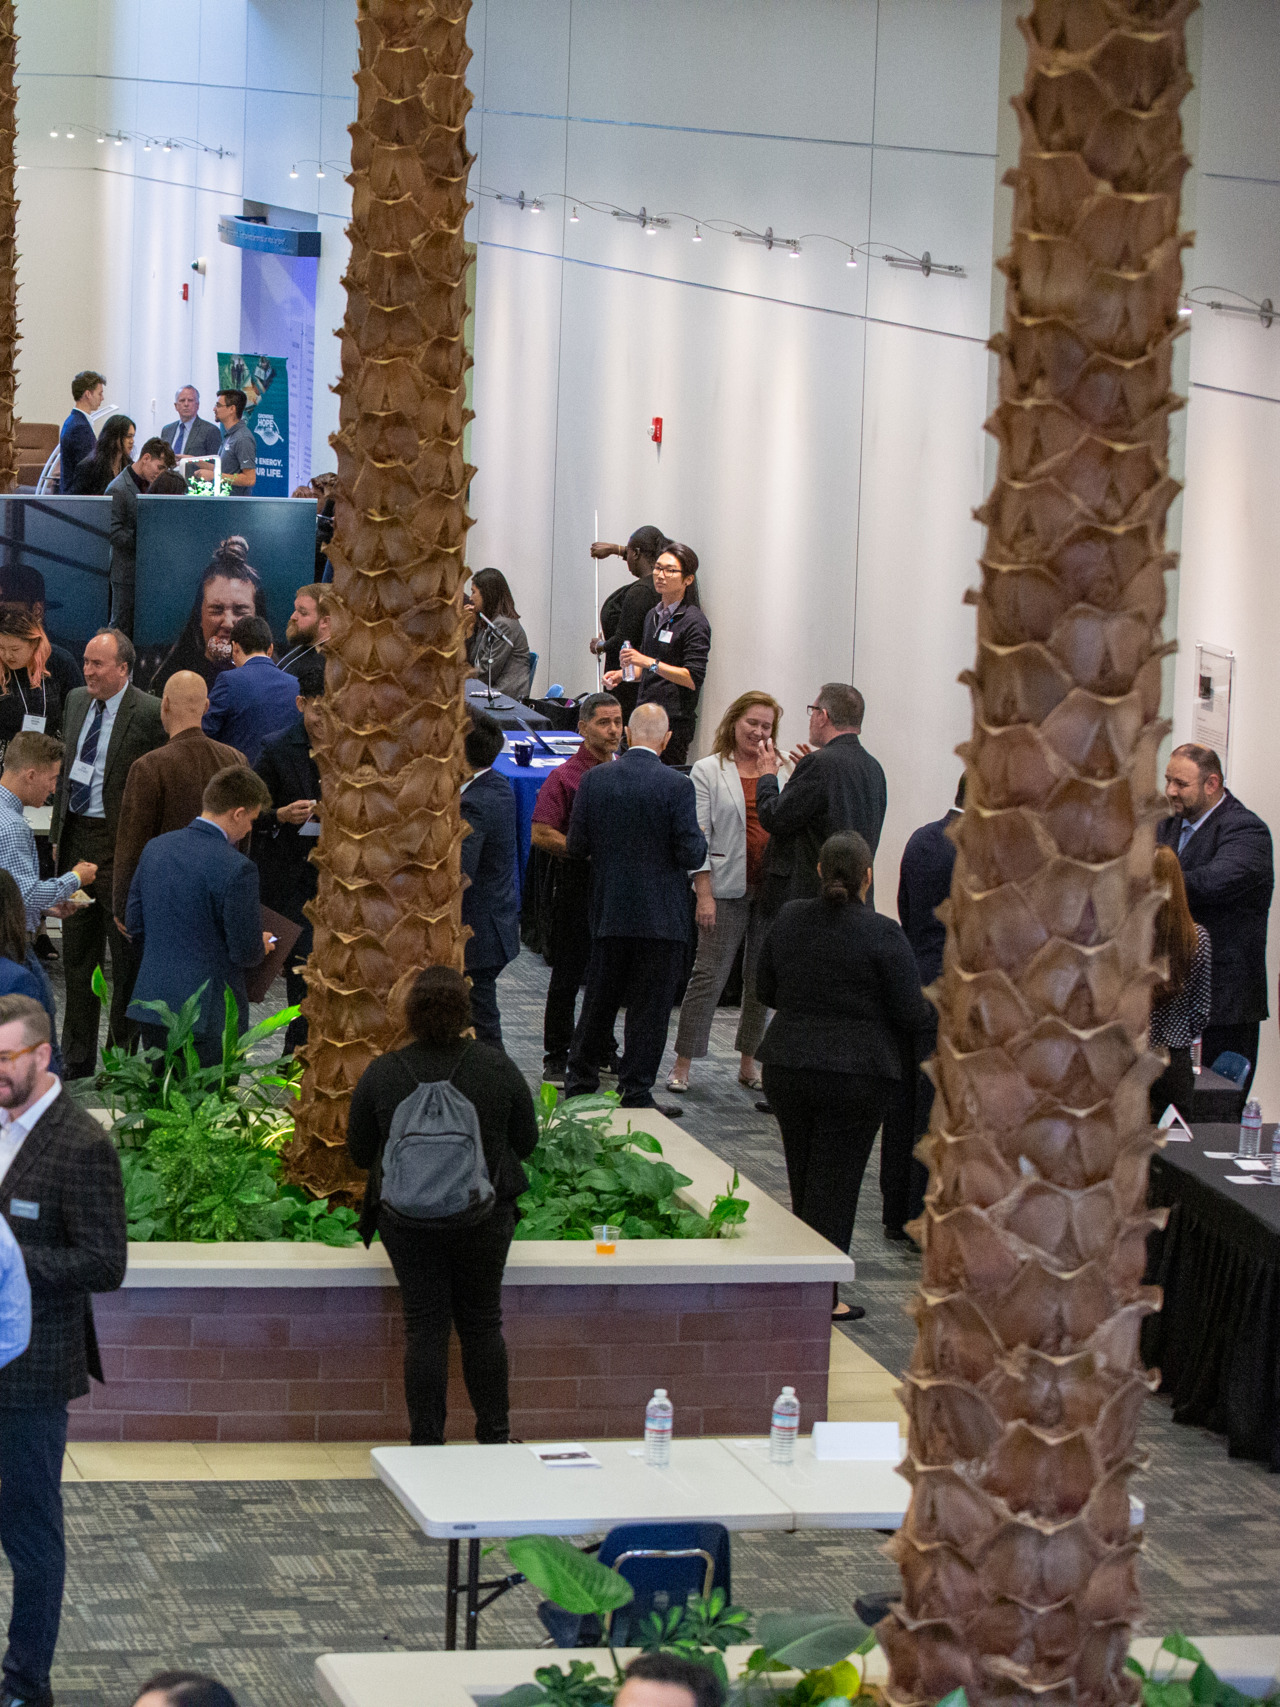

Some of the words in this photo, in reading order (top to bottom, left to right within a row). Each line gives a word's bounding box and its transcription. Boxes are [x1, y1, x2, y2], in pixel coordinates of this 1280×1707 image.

[258, 419, 274, 428] HOPE
[259, 458, 283, 467] ENERGY.
[256, 468, 265, 476] UR
[266, 468, 283, 478] LIFE.
